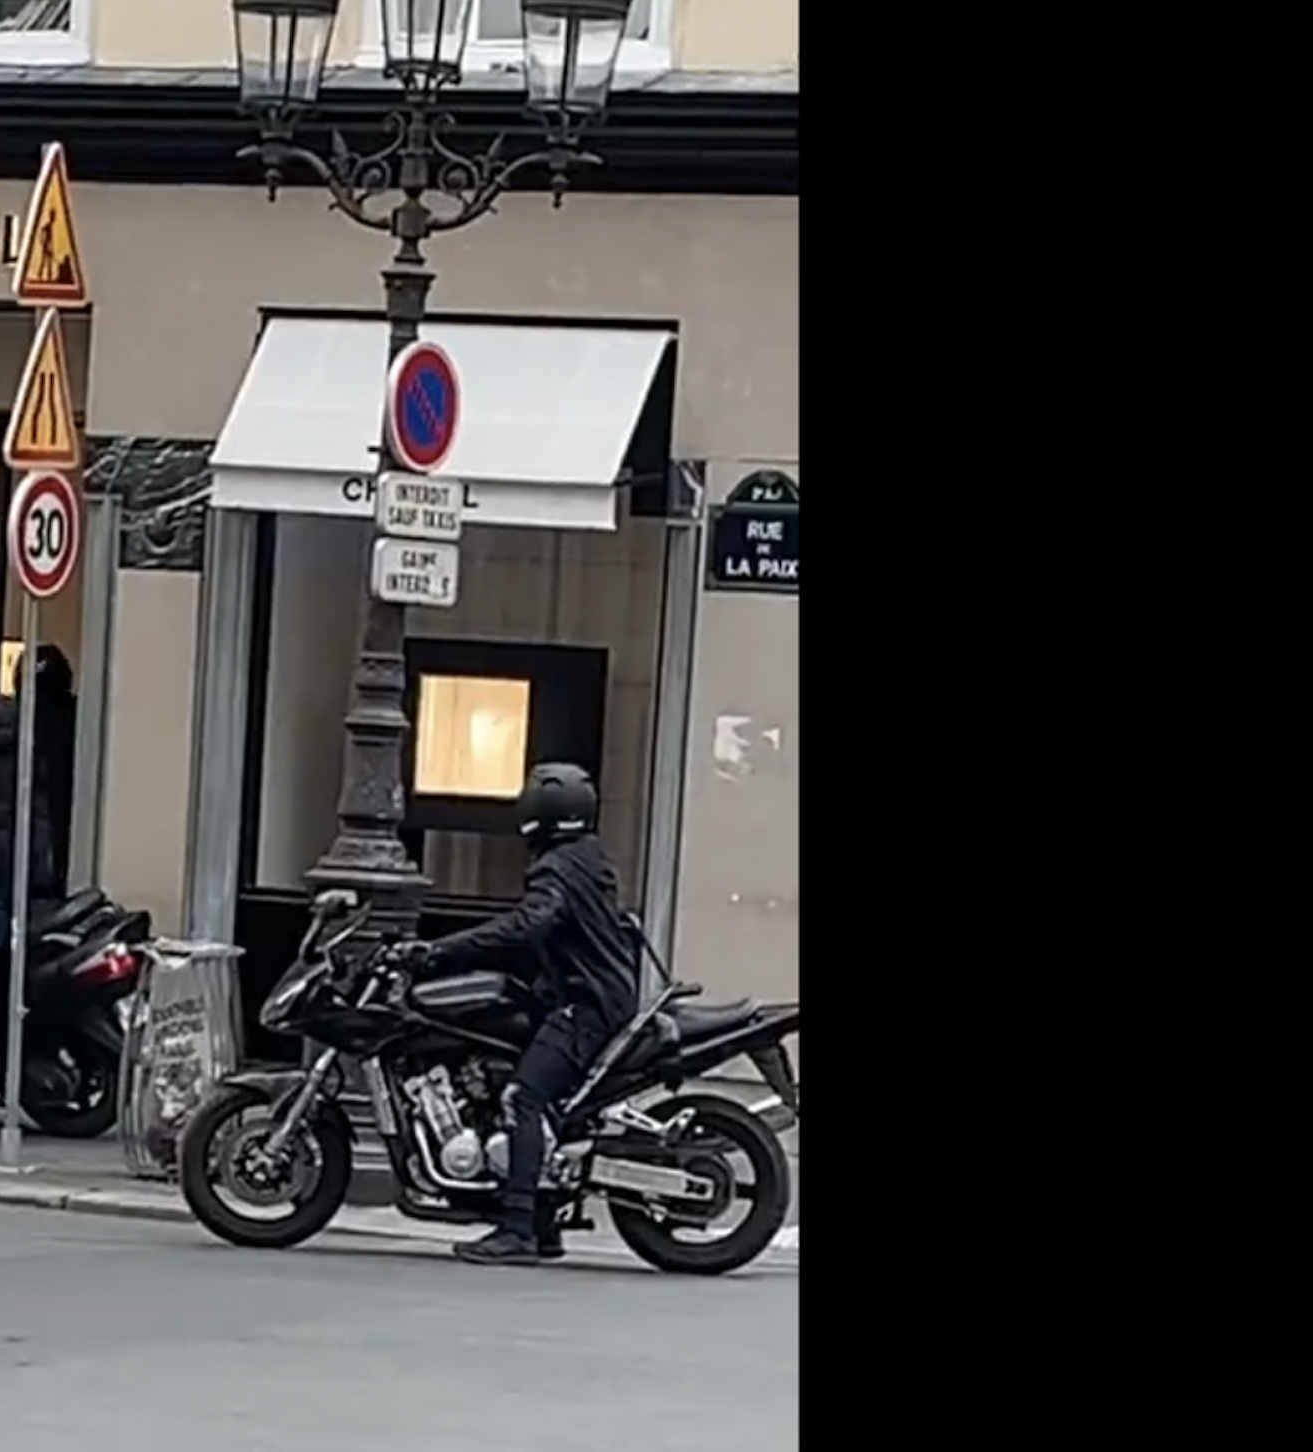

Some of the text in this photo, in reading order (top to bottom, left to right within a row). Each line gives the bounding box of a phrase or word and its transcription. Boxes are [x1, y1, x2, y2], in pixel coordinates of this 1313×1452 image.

[342, 477, 479, 508] CHL
[28, 508, 65, 559] 30
[747, 519, 783, 540] RUE
[725, 556, 799, 579] LA PAIX
